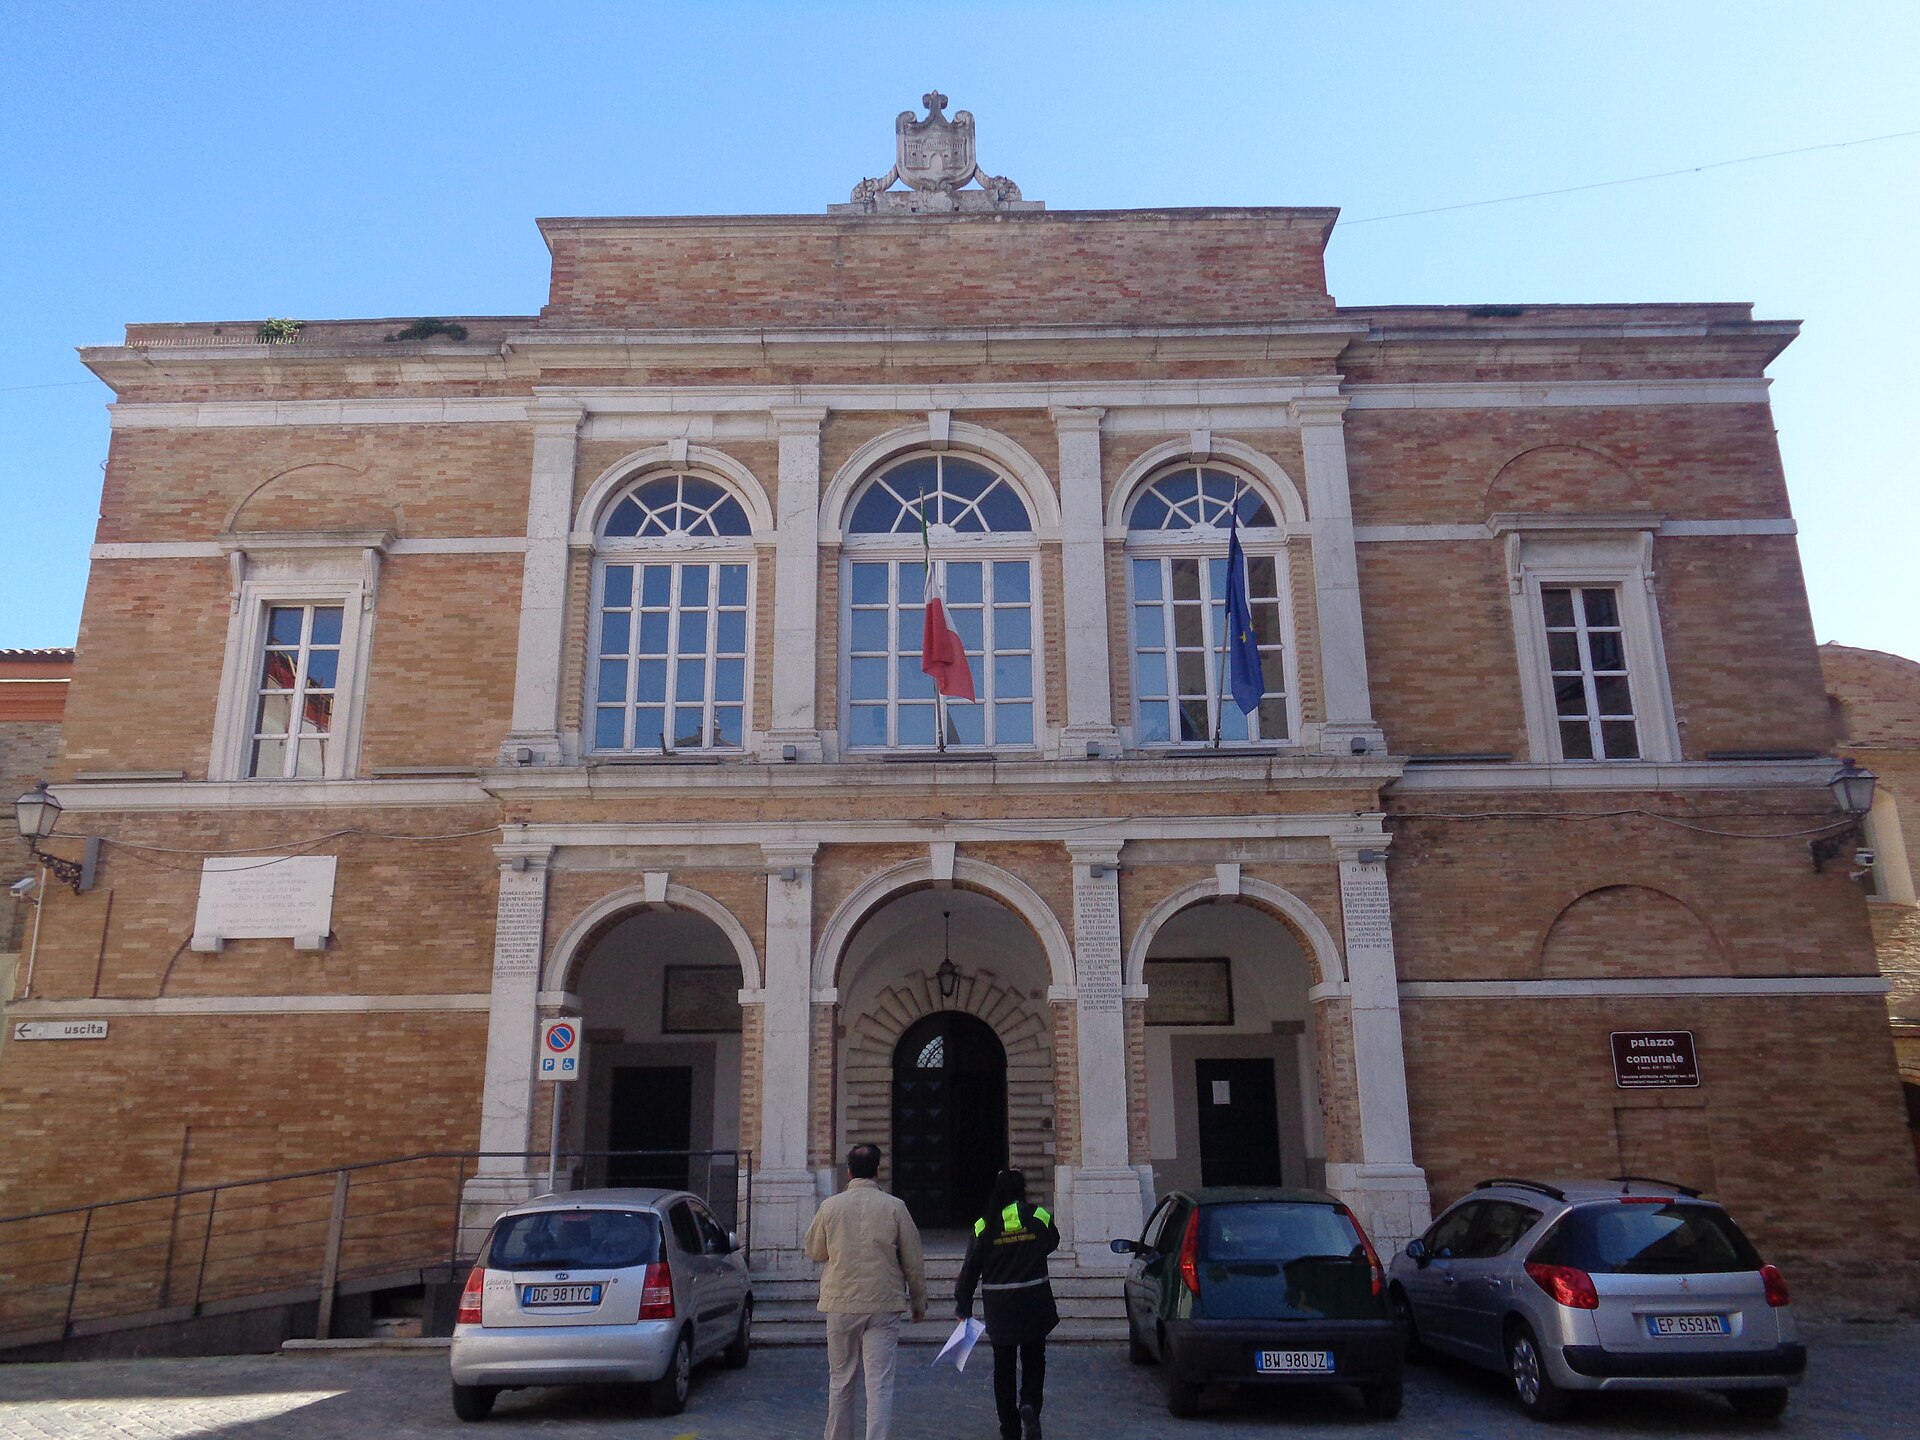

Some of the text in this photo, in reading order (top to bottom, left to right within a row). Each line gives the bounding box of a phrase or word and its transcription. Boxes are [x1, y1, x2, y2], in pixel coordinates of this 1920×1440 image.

[64, 1023, 103, 1034] uscita
[1630, 1037, 1675, 1049] palazzo
[1626, 1053, 1684, 1064] comunale
[545, 1060, 553, 1070] P
[532, 1287, 591, 1302] DG 981YC
[1657, 1317, 1721, 1332] EP 659AM
[1264, 1353, 1326, 1368] BW 980JZ
